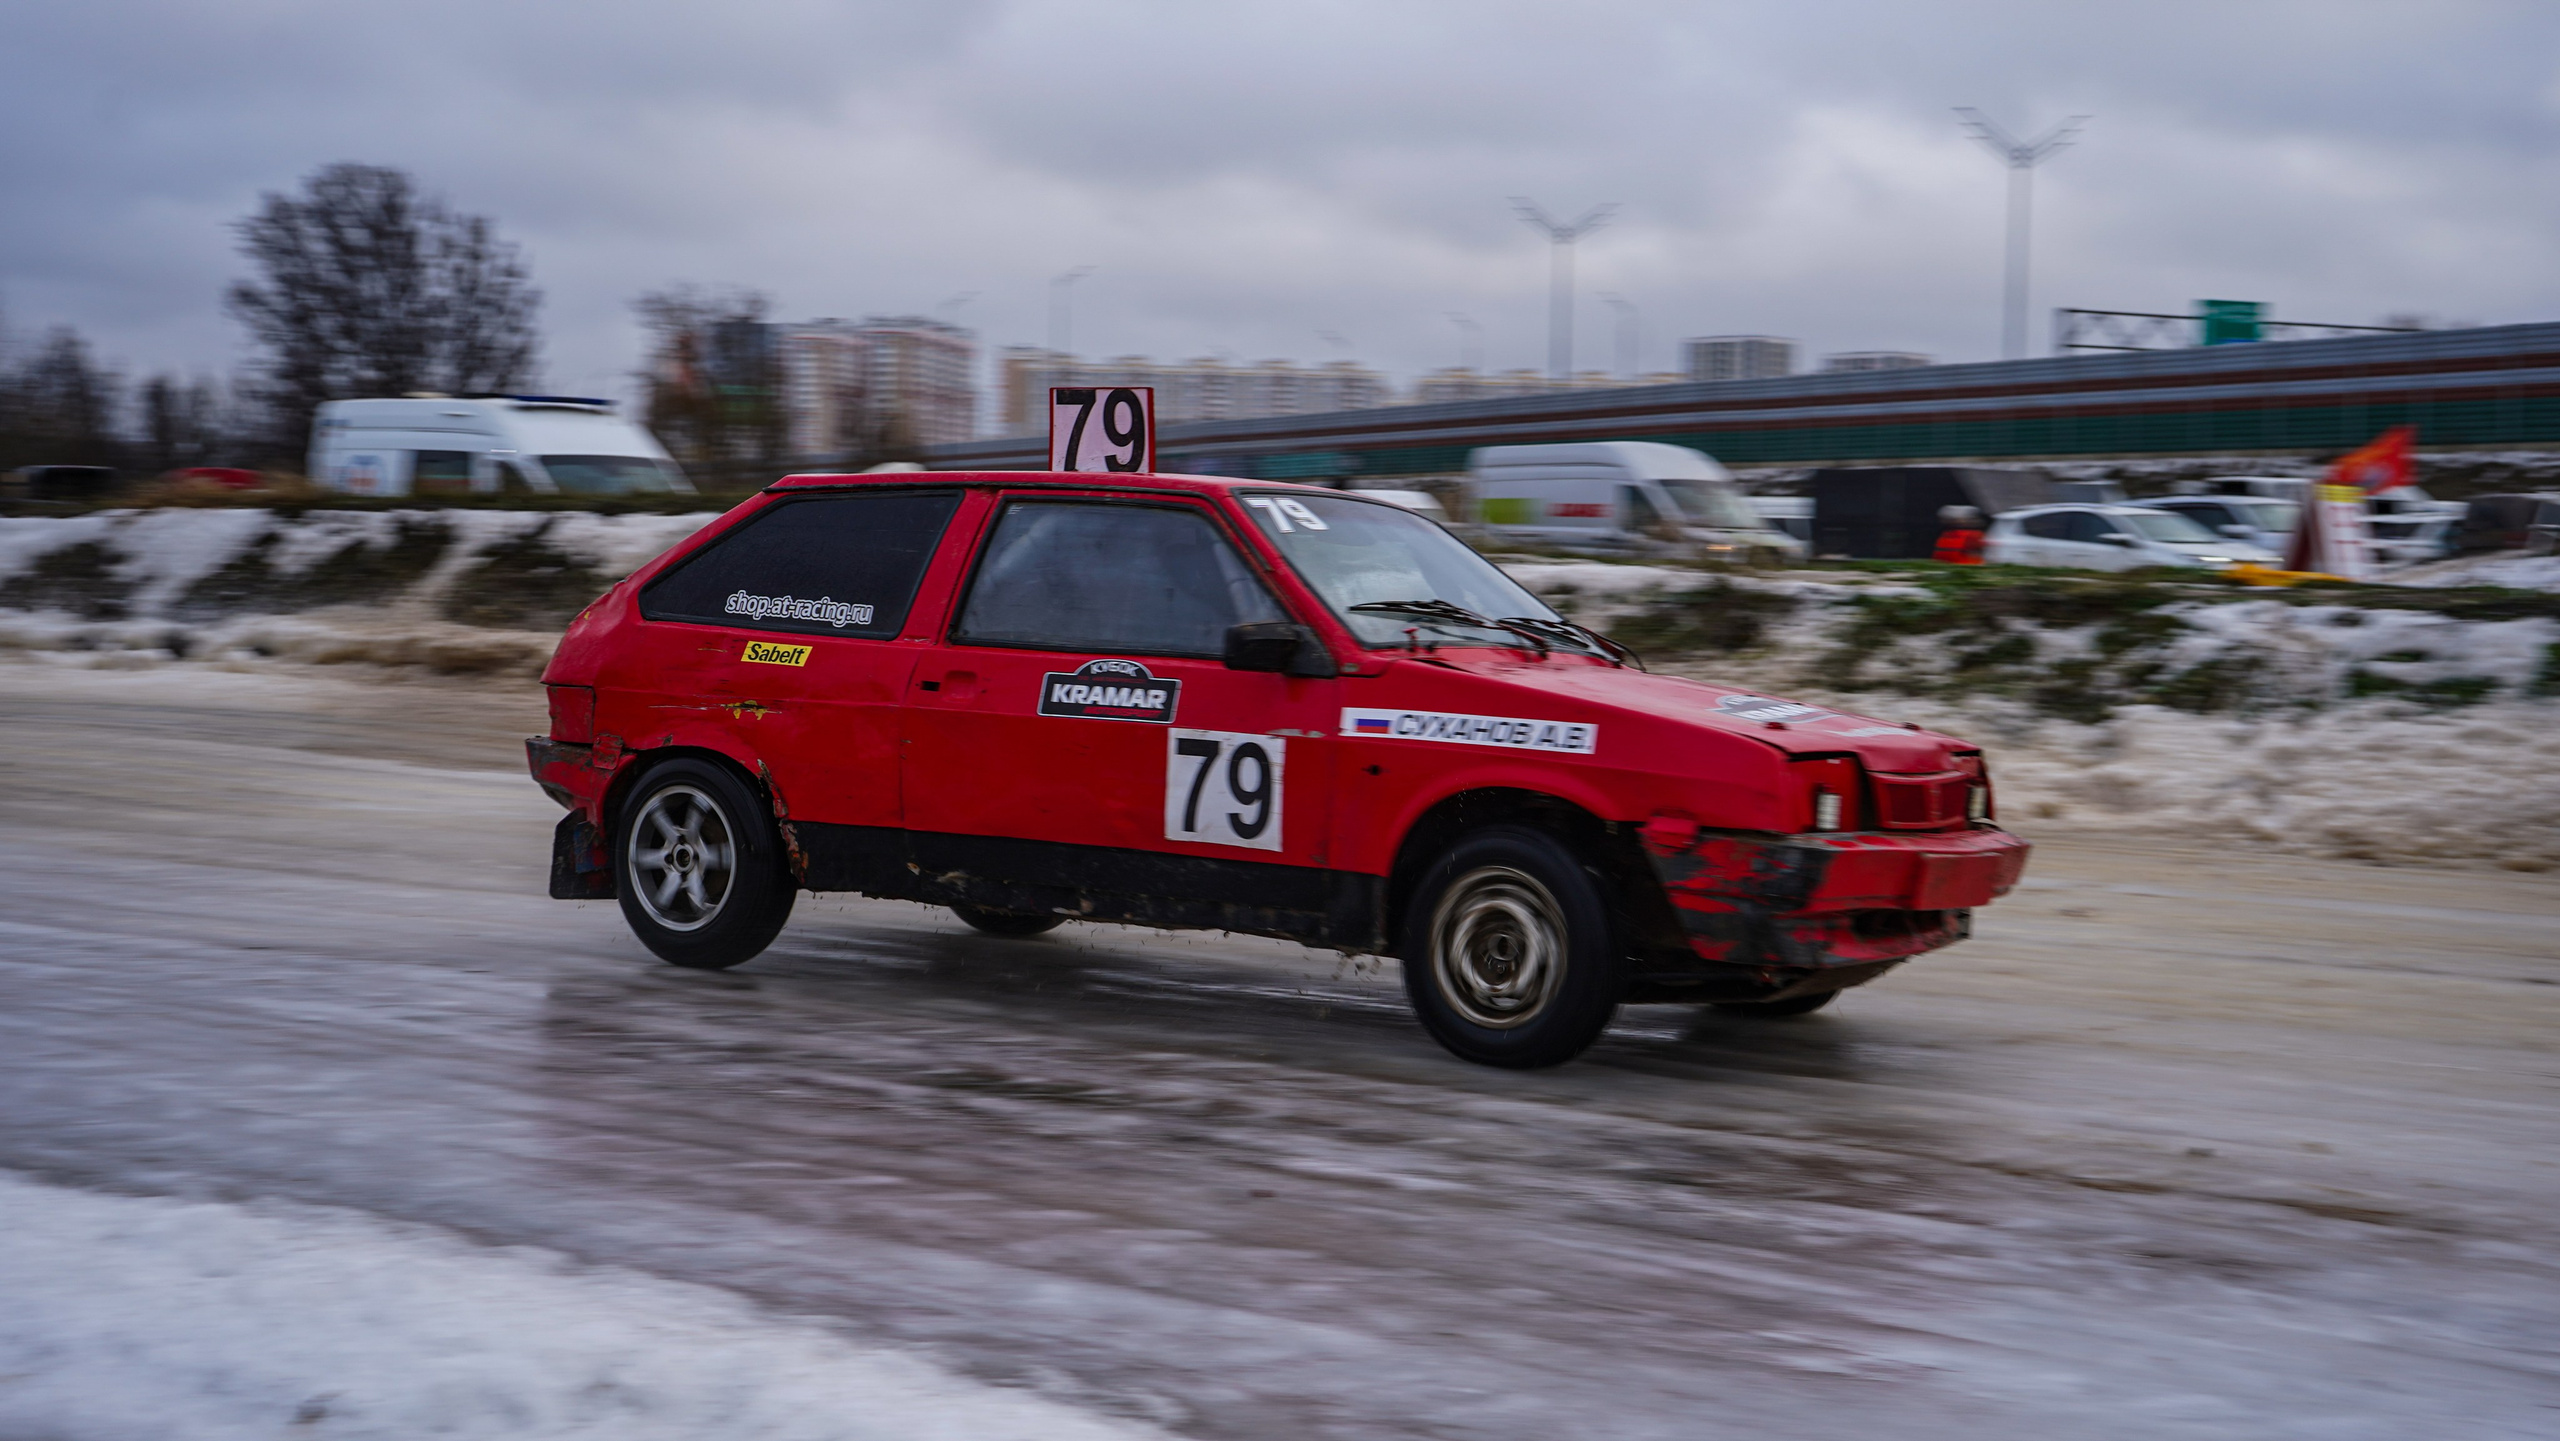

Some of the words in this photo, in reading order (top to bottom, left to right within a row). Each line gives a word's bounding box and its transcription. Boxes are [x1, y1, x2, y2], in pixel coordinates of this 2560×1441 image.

[1056, 388, 1145, 472] 79
[1242, 498, 1330, 533] 79
[725, 590, 873, 627] shop.at-racing.ru
[747, 643, 805, 665] Sabelt
[1050, 683, 1168, 709] KRAMAR
[1396, 714, 1532, 744] СУХАНОВ
[1175, 737, 1271, 839] 79
